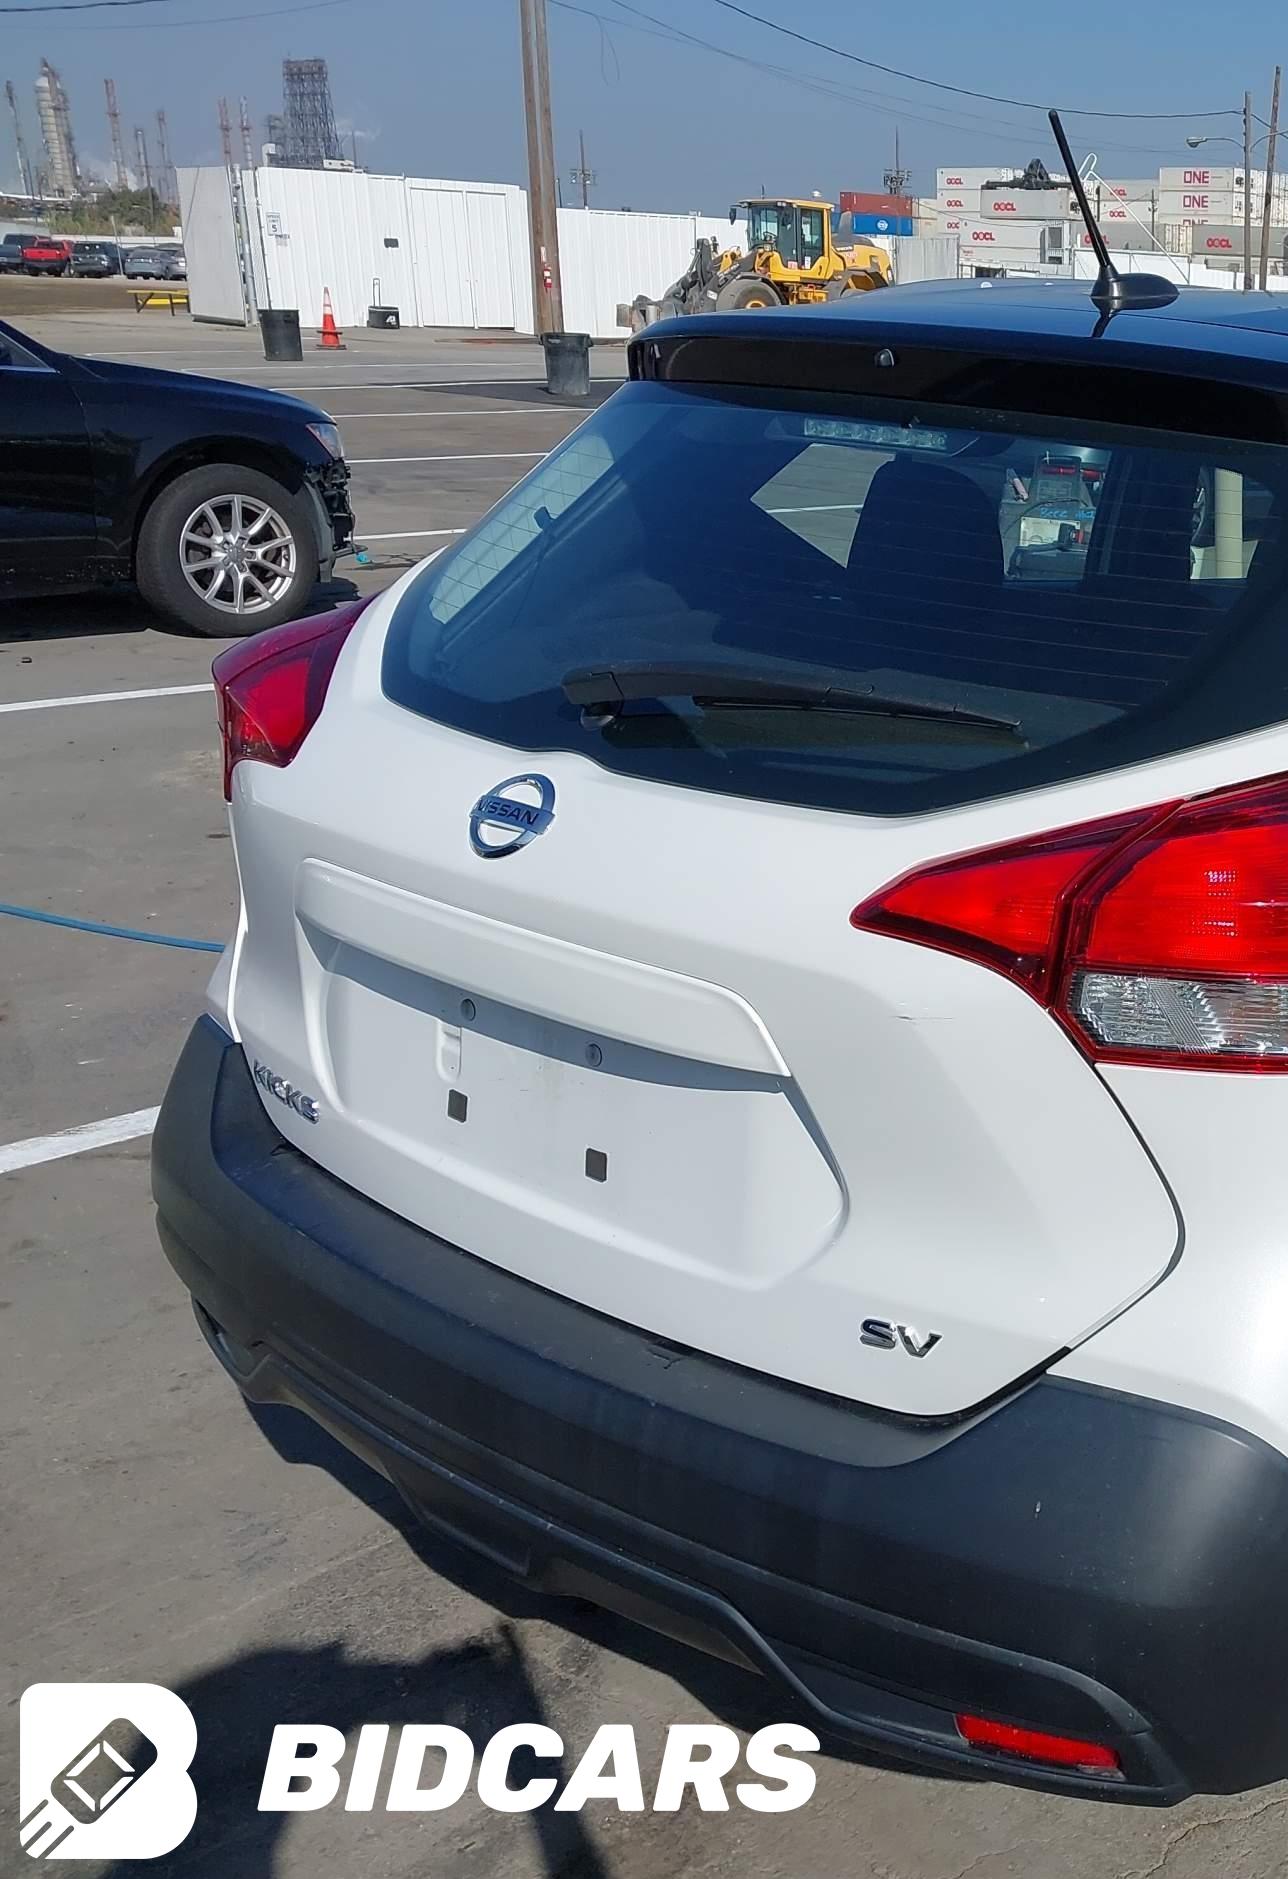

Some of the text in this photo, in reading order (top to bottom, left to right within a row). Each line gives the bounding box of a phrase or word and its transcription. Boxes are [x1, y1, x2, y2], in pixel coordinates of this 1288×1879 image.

[946, 177, 964, 185] OOCL
[1183, 170, 1210, 184] ONE
[946, 199, 964, 207] OOCL
[1182, 194, 1209, 208] ONE
[993, 202, 1017, 211] OOCL
[1109, 210, 1127, 218] OOCL
[972, 231, 996, 241] OOCL
[1206, 238, 1232, 248] OOCL
[476, 798, 540, 826] NISSAN
[253, 1060, 320, 1125] KICKS
[860, 1318, 943, 1358] SV
